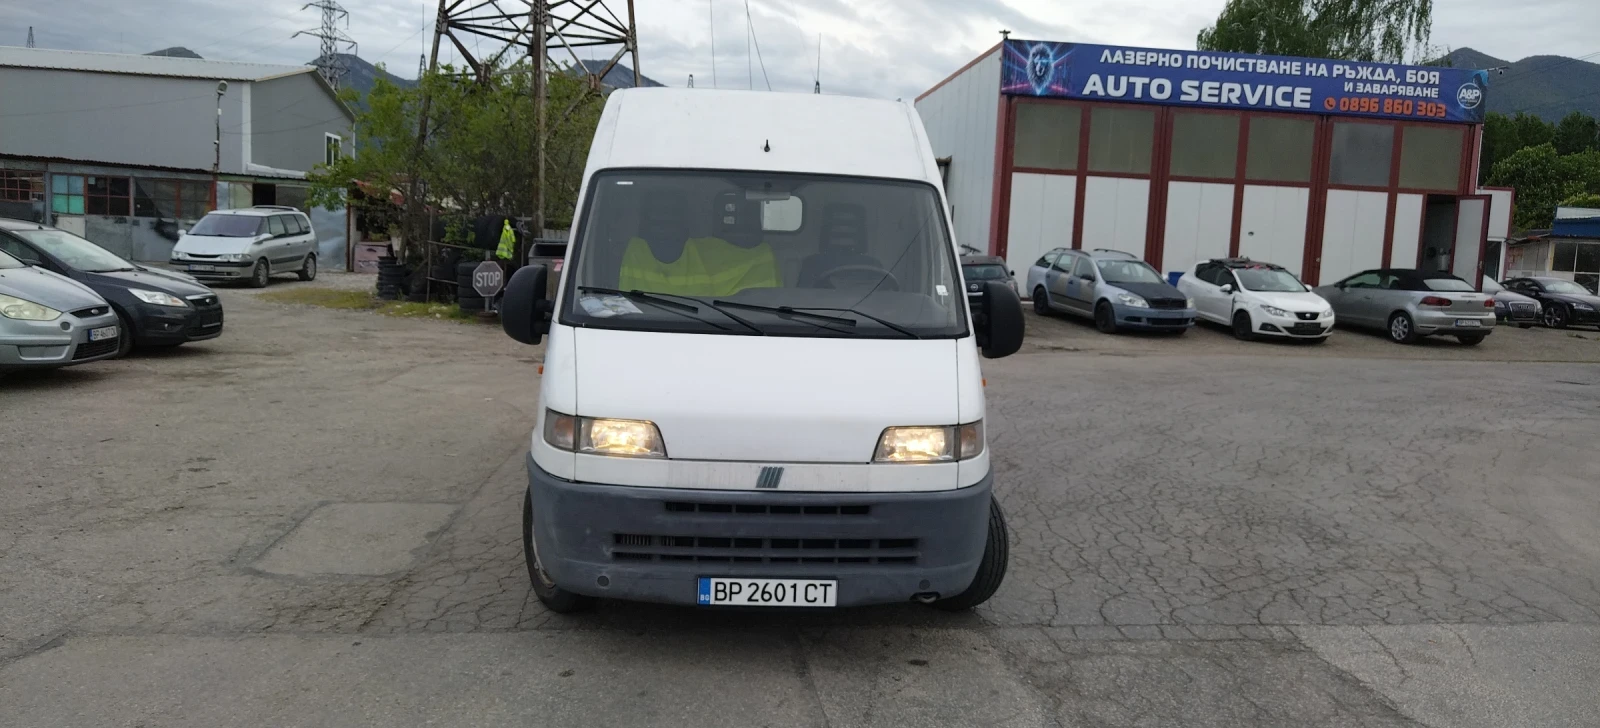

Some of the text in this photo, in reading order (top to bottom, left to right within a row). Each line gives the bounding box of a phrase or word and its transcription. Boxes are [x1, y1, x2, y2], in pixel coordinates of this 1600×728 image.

[1100, 49, 1440, 85] ЛАЗЕРНО ПОЧИСТВАНЕ НА РЪЖДА, БОЯ
[1082, 73, 1312, 109] AUTO SERVICE
[1344, 81, 1440, 98] И ЗАВАРЯВАНЕ
[1458, 88, 1480, 99] A&P
[1340, 97, 1379, 113] 0896
[1383, 98, 1413, 115] 860
[1416, 101, 1446, 117] 303
[475, 271, 501, 287] STOP
[714, 581, 832, 603] BP 2601 CT
